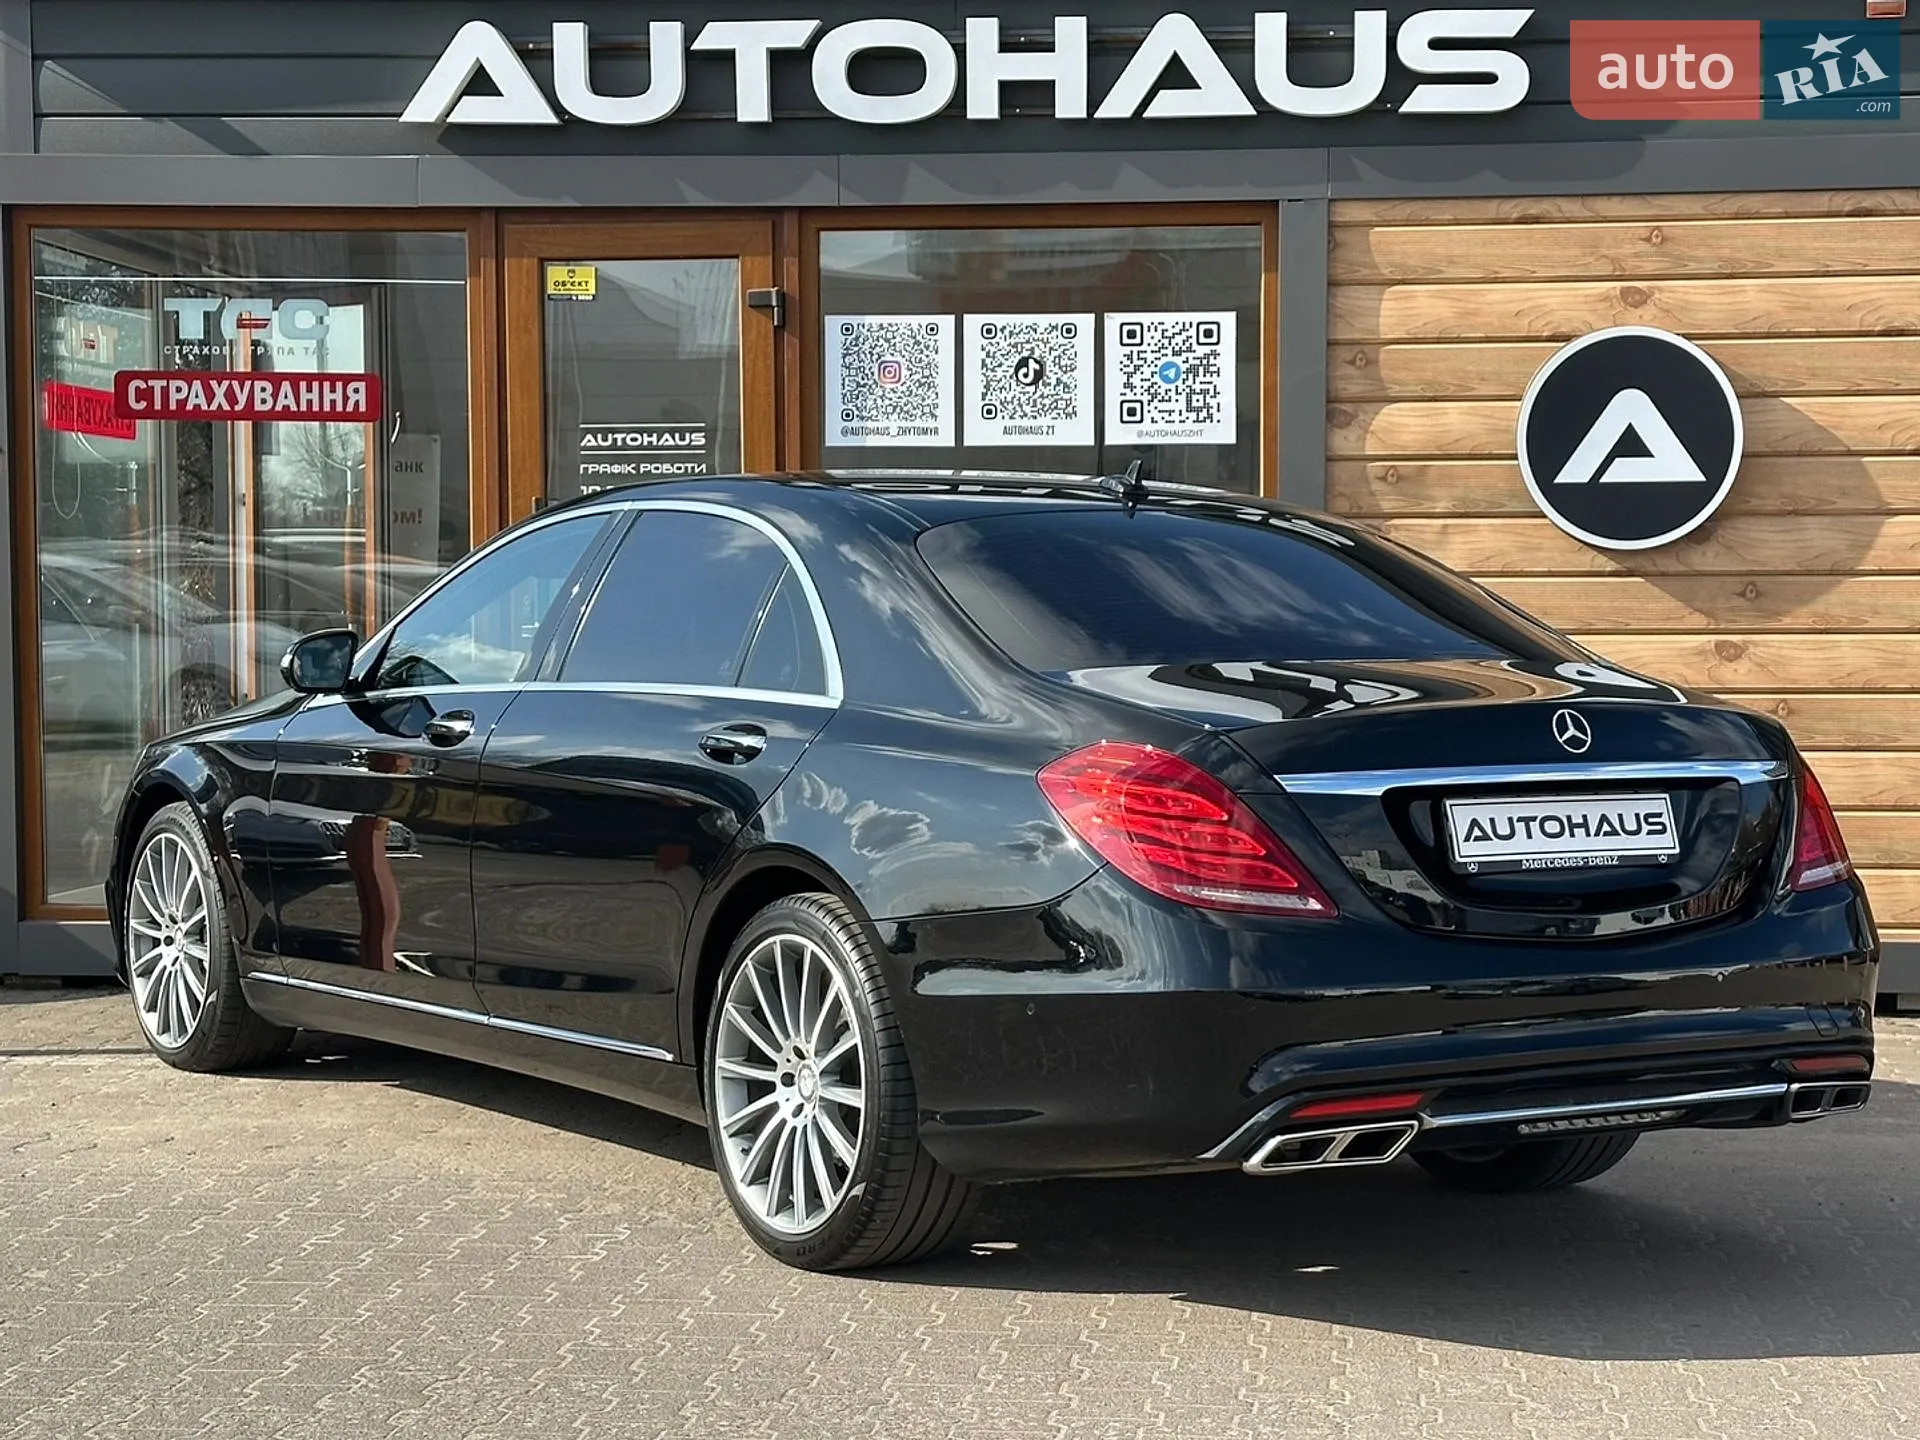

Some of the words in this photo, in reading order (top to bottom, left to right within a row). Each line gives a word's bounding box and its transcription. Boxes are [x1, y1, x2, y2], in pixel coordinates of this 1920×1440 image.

[400, 9, 1534, 126] AUTOHAUS
[127, 379, 367, 413] СТРАХУВАННЯ
[580, 432, 706, 447] AUTOHAUS
[1003, 425, 1044, 436] AUTOHAUS
[1046, 425, 1055, 436] ZT
[580, 463, 637, 474] ГРАФІК
[640, 463, 706, 474] РОБОТИ
[1463, 812, 1668, 843] AUTOHAUS
